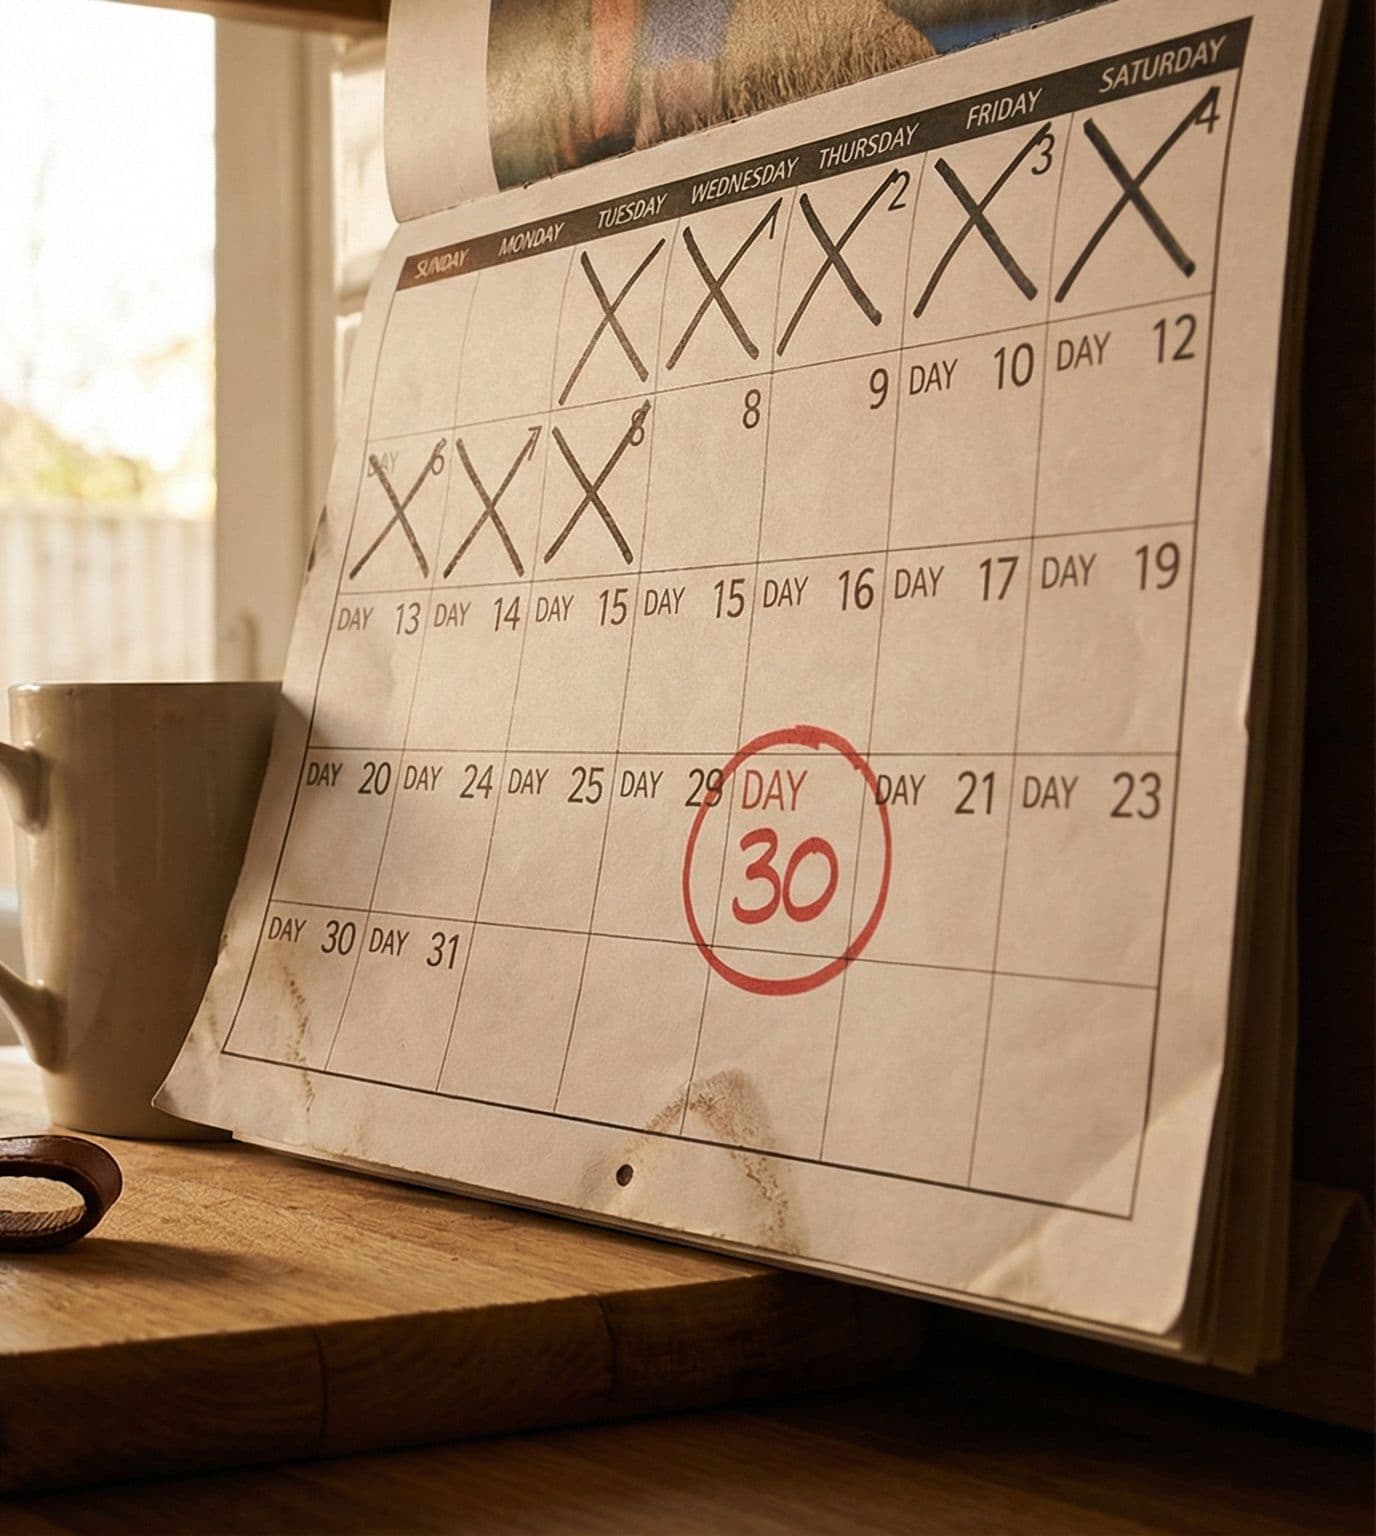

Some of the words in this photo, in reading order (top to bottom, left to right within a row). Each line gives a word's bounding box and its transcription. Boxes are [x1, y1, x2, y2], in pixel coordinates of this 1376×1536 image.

[414, 248, 470, 280] SUNDAY
[498, 222, 564, 257] MONDAY
[597, 193, 667, 230] TUESDAY
[691, 157, 800, 205] WEDNESDAY
[820, 123, 920, 169] THURSDAY
[966, 88, 1042, 130] FRIDAY
[1098, 36, 1226, 93] SATURDAY
[887, 168, 910, 211] 2
[1031, 132, 1055, 175] 3
[1194, 86, 1221, 134] 4
[527, 426, 542, 461] 7
[742, 388, 761, 429] 8
[869, 368, 889, 410] 9
[909, 358, 958, 395] DAY
[994, 343, 1034, 390] 10
[1057, 331, 1111, 372] DAY
[1153, 313, 1197, 364] 12
[337, 607, 374, 631] DAY
[396, 602, 421, 635] 13
[434, 601, 472, 627] DAY
[494, 596, 521, 632] 14
[535, 594, 574, 623] DAY
[599, 588, 629, 626] 15
[644, 587, 686, 616] DAY
[714, 578, 746, 619] 15
[763, 576, 809, 608] DAY
[838, 567, 874, 611] 16
[894, 565, 945, 599] DAY
[979, 556, 1019, 601] 17
[1041, 553, 1097, 590] DAY
[1135, 541, 1180, 591] 19
[306, 762, 343, 787] DAY
[358, 761, 392, 796] 20
[403, 765, 443, 791] DAY
[460, 764, 494, 799] 24
[508, 768, 550, 795] DAY
[567, 766, 605, 804] 25
[620, 770, 664, 798] DAY
[684, 768, 724, 808] 29
[741, 769, 808, 811] DAY
[875, 774, 926, 806] DAY
[955, 770, 995, 815] 21
[1022, 775, 1079, 809] DAY
[1110, 771, 1162, 820] 23
[731, 827, 839, 925] 30
[268, 916, 307, 943] DAY
[321, 920, 357, 956] 30
[368, 928, 410, 957] DAY
[426, 931, 460, 970] 31
